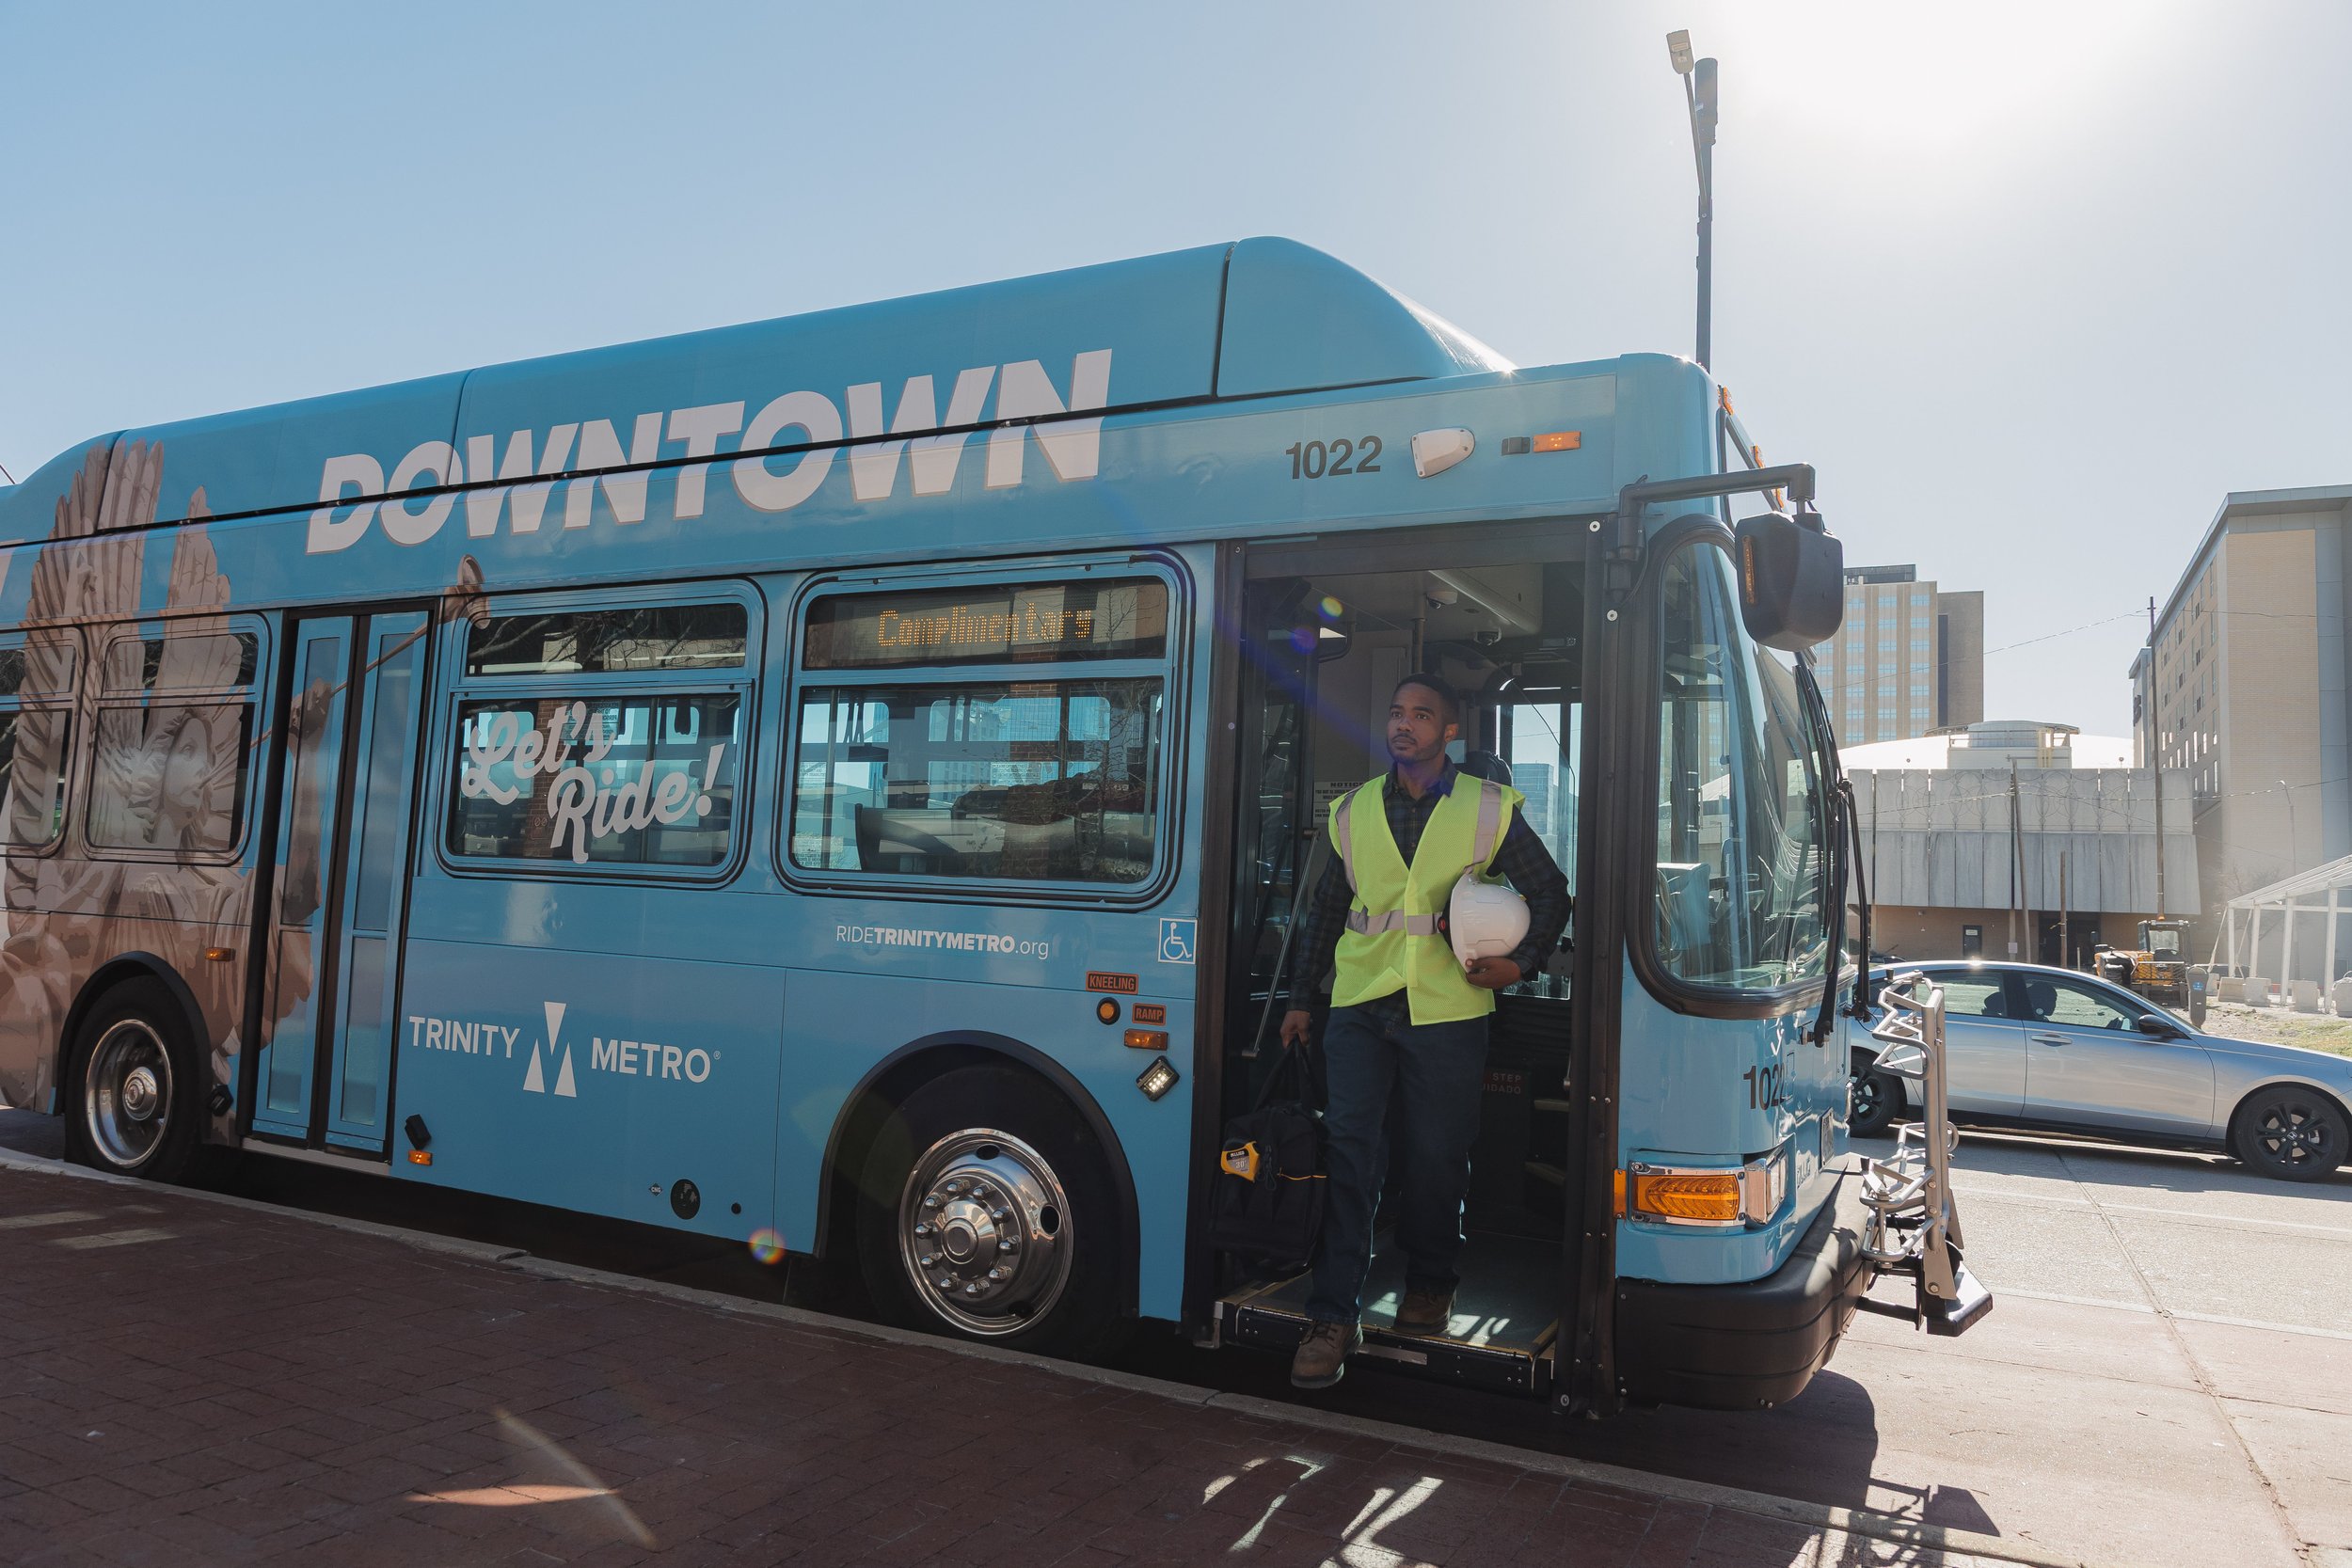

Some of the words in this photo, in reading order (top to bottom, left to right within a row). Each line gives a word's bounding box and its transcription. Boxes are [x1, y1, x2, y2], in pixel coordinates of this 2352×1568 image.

[306, 349, 1112, 554] DOWNTOWN
[1285, 436, 1383, 480] 1022
[878, 602, 1091, 646] Complimentary
[461, 701, 616, 805] Let's
[548, 743, 725, 864] Ride!
[836, 926, 1049, 960] RIDETRINITYMETRO.org
[1089, 974, 1135, 990] KNEELING
[1136, 1007, 1163, 1021] RAMP
[408, 1016, 520, 1058] TRINITY
[1483, 1084, 1521, 1095] IDADO
[1492, 1072, 1521, 1083] STEP
